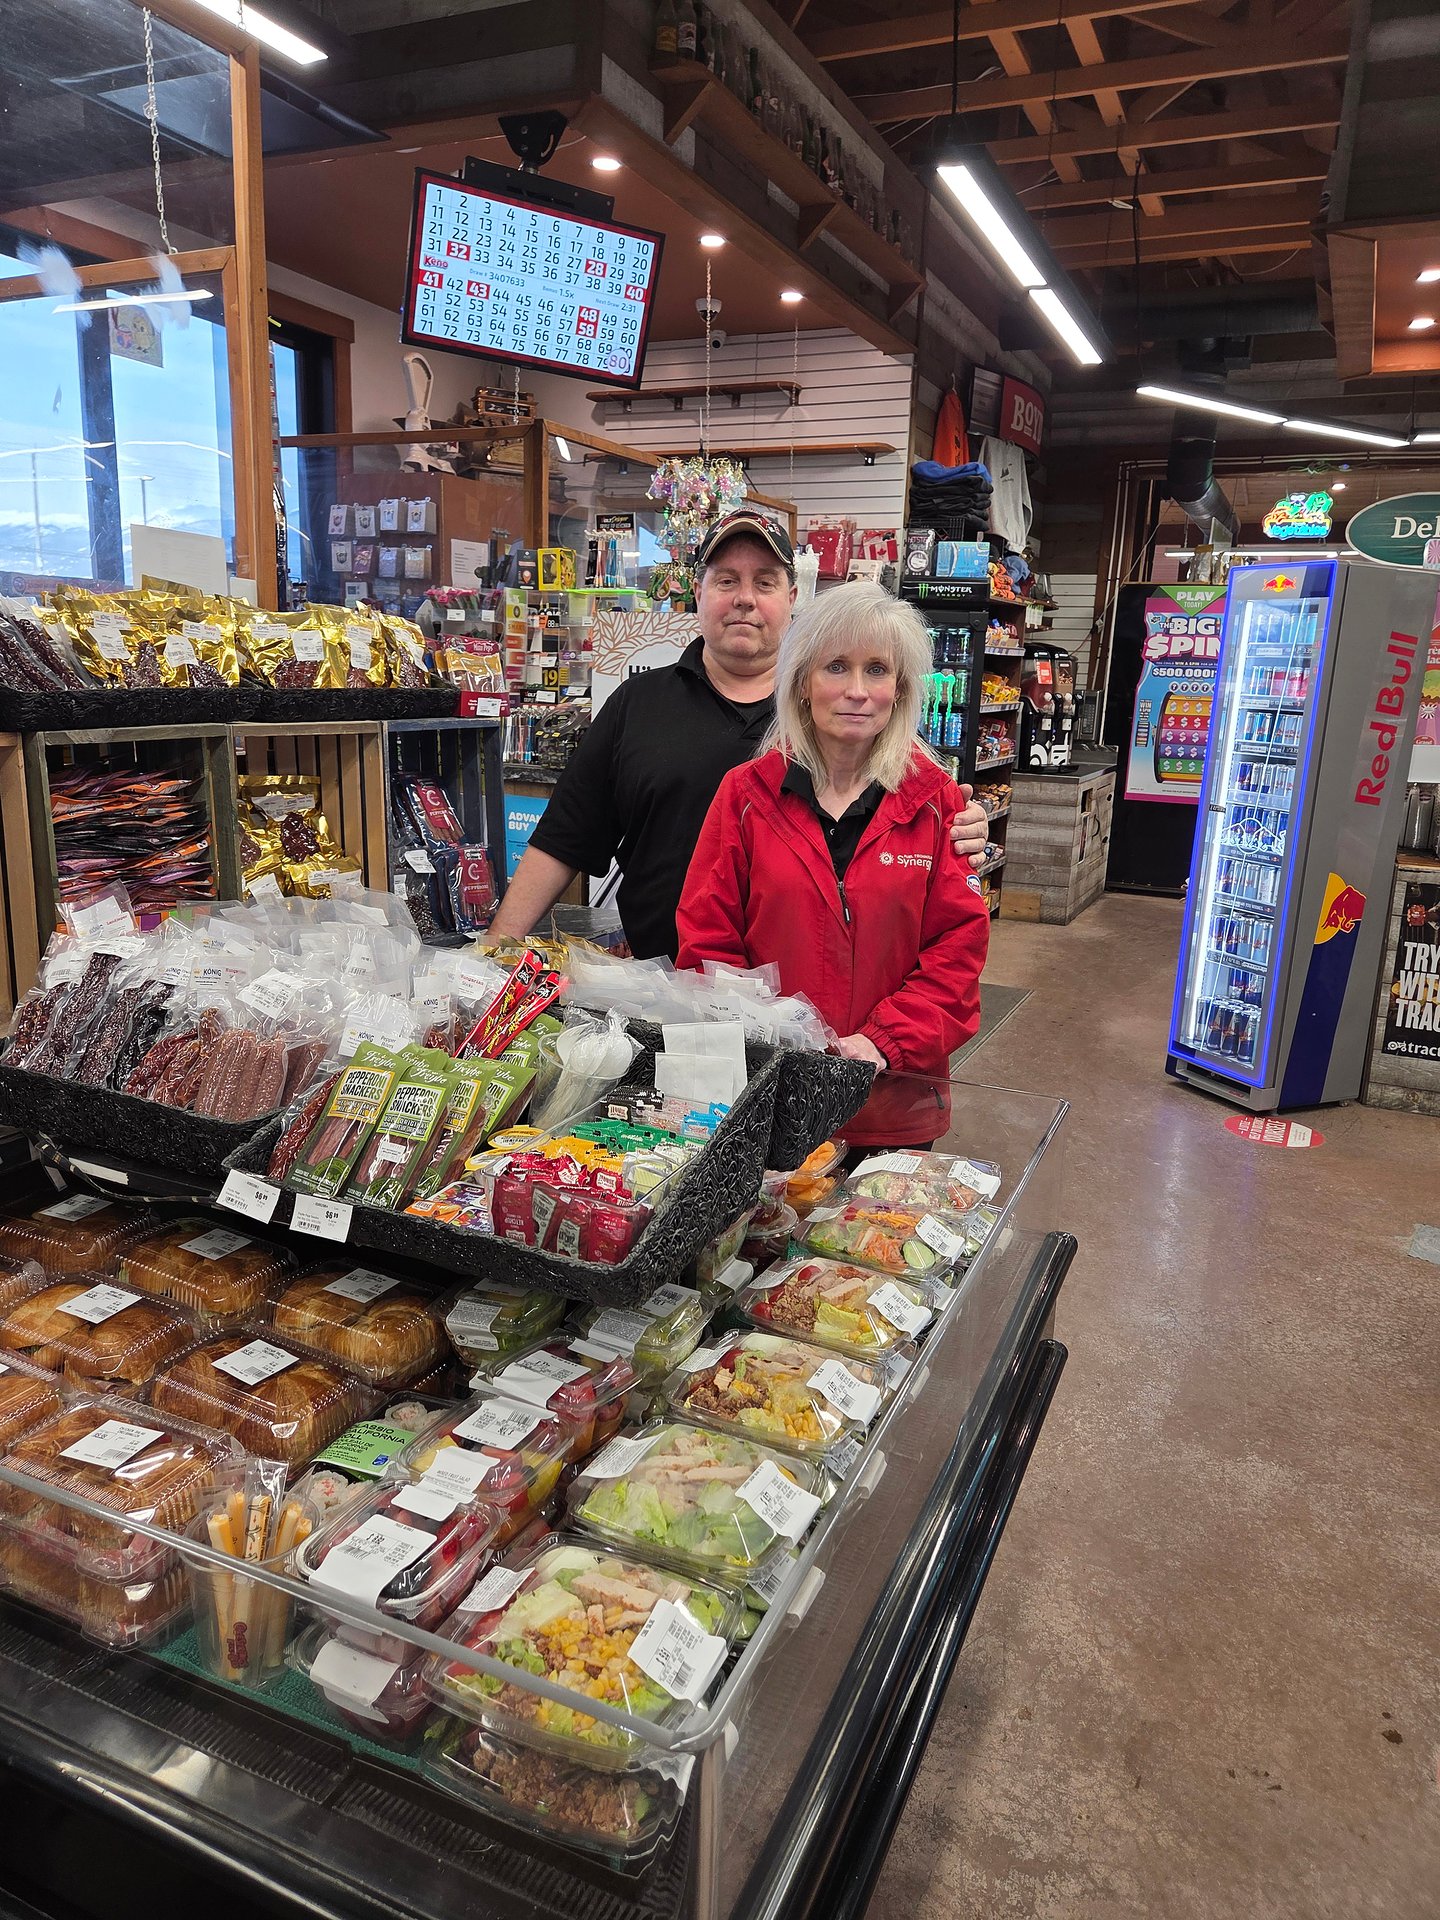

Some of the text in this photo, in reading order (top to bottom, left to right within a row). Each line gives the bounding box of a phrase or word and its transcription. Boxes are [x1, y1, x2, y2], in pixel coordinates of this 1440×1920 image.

[437, 190, 649, 255] 1 2 3 4 5 6 7 8 9 10
[432, 205, 648, 270] 11 12 13 14 15 16 17 18 19 20
[424, 254, 448, 269] Keno
[429, 221, 645, 285] 21 22 23 24 25 26 27 28 29 30
[428, 238, 644, 300] 31 32 33 34 35 36 37 38 39 40
[489, 272, 525, 287] 3407633
[423, 272, 637, 330] 41 42 43 44 45 46 47 48 49 50
[559, 288, 574, 299] 1.5x
[423, 288, 635, 345] 51 52 53 54 55 56 57 58 59 60
[621, 303, 636, 313] 2:31
[422, 304, 434, 317] 61
[444, 309, 460, 322] 62
[468, 314, 482, 327] 63
[490, 319, 505, 332] 64
[513, 324, 527, 336] 65
[534, 328, 549, 342] 66
[556, 334, 571, 346] 67
[577, 338, 592, 350] 68
[598, 342, 612, 355] 69
[420, 319, 432, 332] 71
[443, 324, 457, 338] 72
[467, 329, 480, 342] 73
[489, 334, 503, 347] 74
[512, 338, 525, 352] 75
[534, 343, 546, 356] 76
[556, 348, 568, 360] 77
[576, 352, 589, 365] 78
[609, 355, 627, 369] 80
[931, 585, 972, 594] MONSTER
[1176, 592, 1215, 601] PLAY
[1169, 618, 1215, 635] BIG
[543, 669, 558, 686] 19
[1355, 630, 1419, 806] Red Bull
[508, 822, 530, 831] BUY
[203, 968, 221, 976] KÖNIG
[1400, 970, 1440, 1002] WIT
[358, 1031, 374, 1042] KÖNIG
[347, 1070, 388, 1089] PEPPERONI
[340, 1084, 382, 1101] SNACKERS
